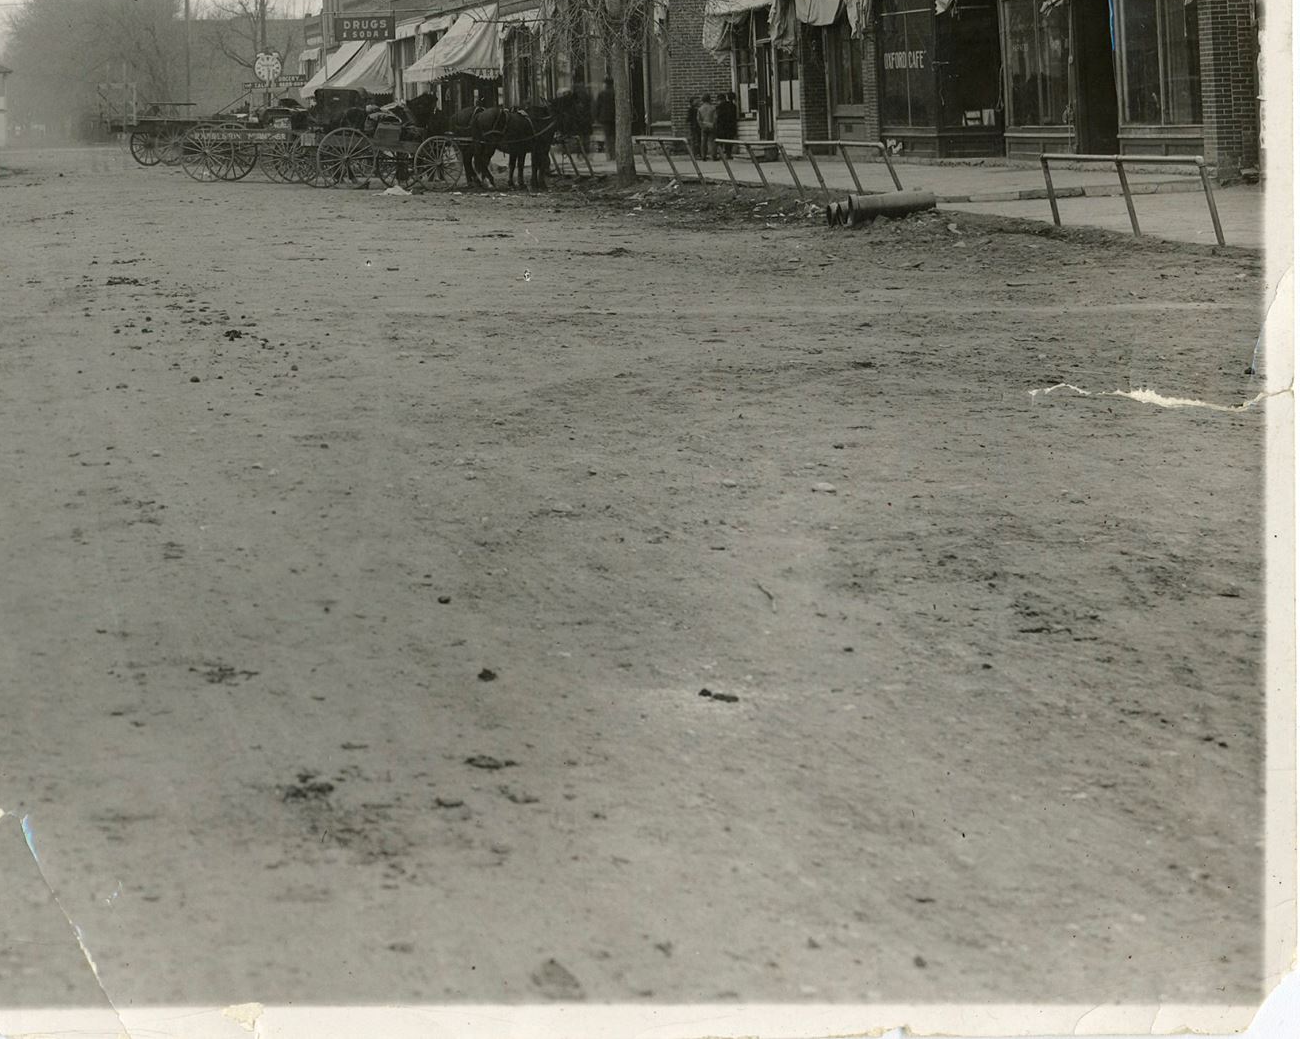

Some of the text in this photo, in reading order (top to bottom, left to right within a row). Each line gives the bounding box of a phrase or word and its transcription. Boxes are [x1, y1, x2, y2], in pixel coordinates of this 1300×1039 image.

[343, 19, 388, 29] DRUGS
[352, 30, 379, 38] SODA
[883, 51, 907, 70] OXFORD
